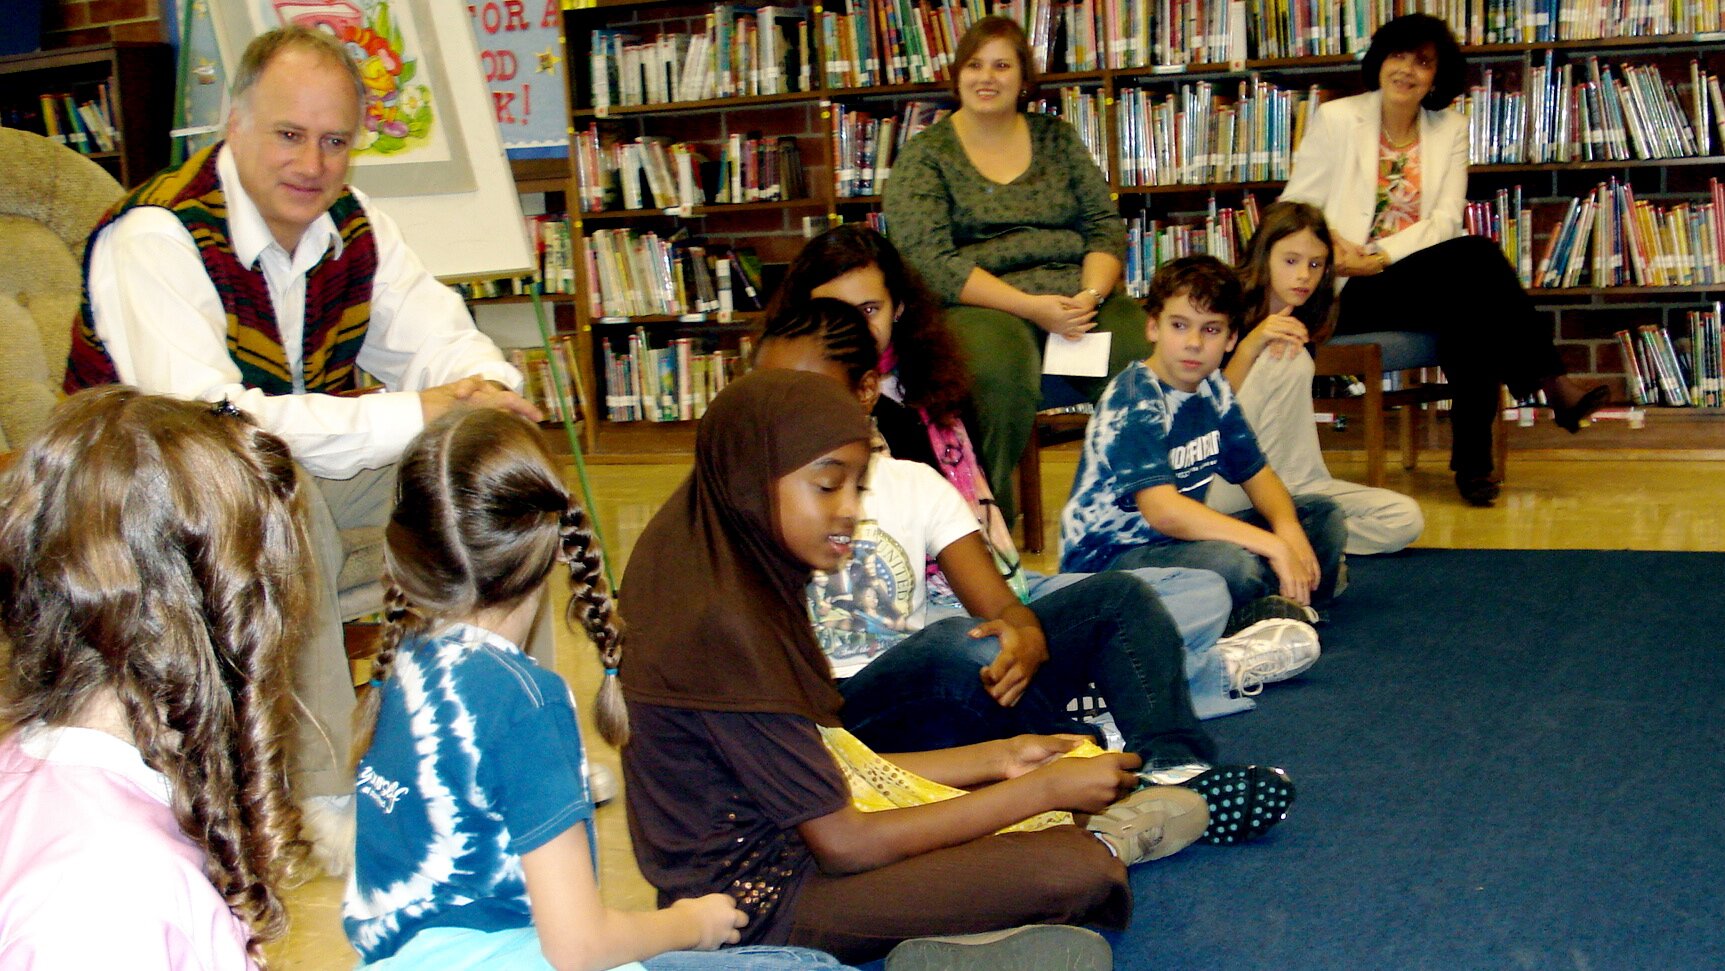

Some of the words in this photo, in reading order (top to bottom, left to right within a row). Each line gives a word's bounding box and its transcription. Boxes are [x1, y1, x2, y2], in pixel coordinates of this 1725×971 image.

[467, 0, 529, 34] OR
[491, 84, 530, 125] K!
[877, 540, 910, 601] UNITED
